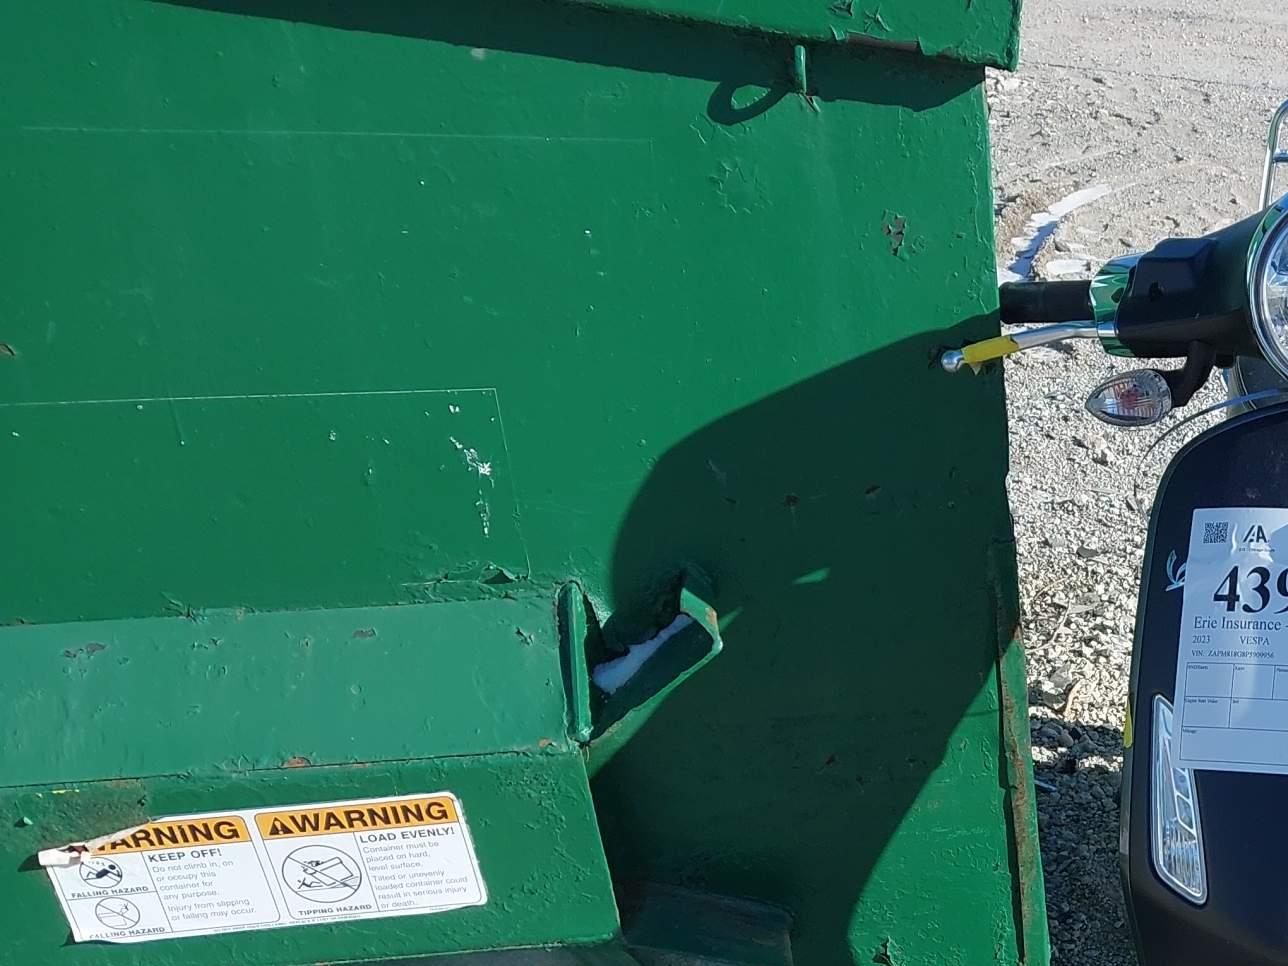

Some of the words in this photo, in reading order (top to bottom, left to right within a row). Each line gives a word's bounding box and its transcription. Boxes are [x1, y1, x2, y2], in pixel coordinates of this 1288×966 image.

[1194, 616, 1217, 629] Erie
[1221, 616, 1281, 631] Insurance
[1192, 635, 1210, 644] 2023
[1240, 636, 1270, 645] VESPA
[289, 801, 449, 833] WARNING
[97, 821, 240, 851] ARNING
[359, 832, 397, 843] LOAD
[401, 827, 455, 839] EVENLY!
[362, 845, 404, 854] Container
[406, 842, 426, 850] must
[148, 851, 186, 862] KEEP
[190, 848, 222, 858] OFF!
[366, 853, 394, 863] placed
[167, 864, 181, 872] not
[184, 862, 207, 871] climb
[167, 873, 198, 882] occupy
[200, 870, 217, 878] this
[372, 874, 396, 882] Tilted
[408, 870, 445, 879] unevenly
[160, 881, 200, 892] container
[375, 883, 404, 891] loaded
[405, 879, 443, 888] container
[445, 876, 468, 884] could
[71, 890, 109, 898] FALLING
[111, 886, 149, 894] HAZARD
[444, 886, 467, 895] injury
[164, 893, 179, 901] any
[168, 903, 192, 913] Injury
[194, 902, 215, 910] from
[216, 898, 250, 908] slipping
[298, 908, 333, 917] TIPPING
[336, 904, 372, 913] HAZARD
[182, 910, 208, 920] falling
[210, 910, 228, 919] may
[231, 907, 256, 916] occur.
[128, 927, 165, 937] HAZARD
